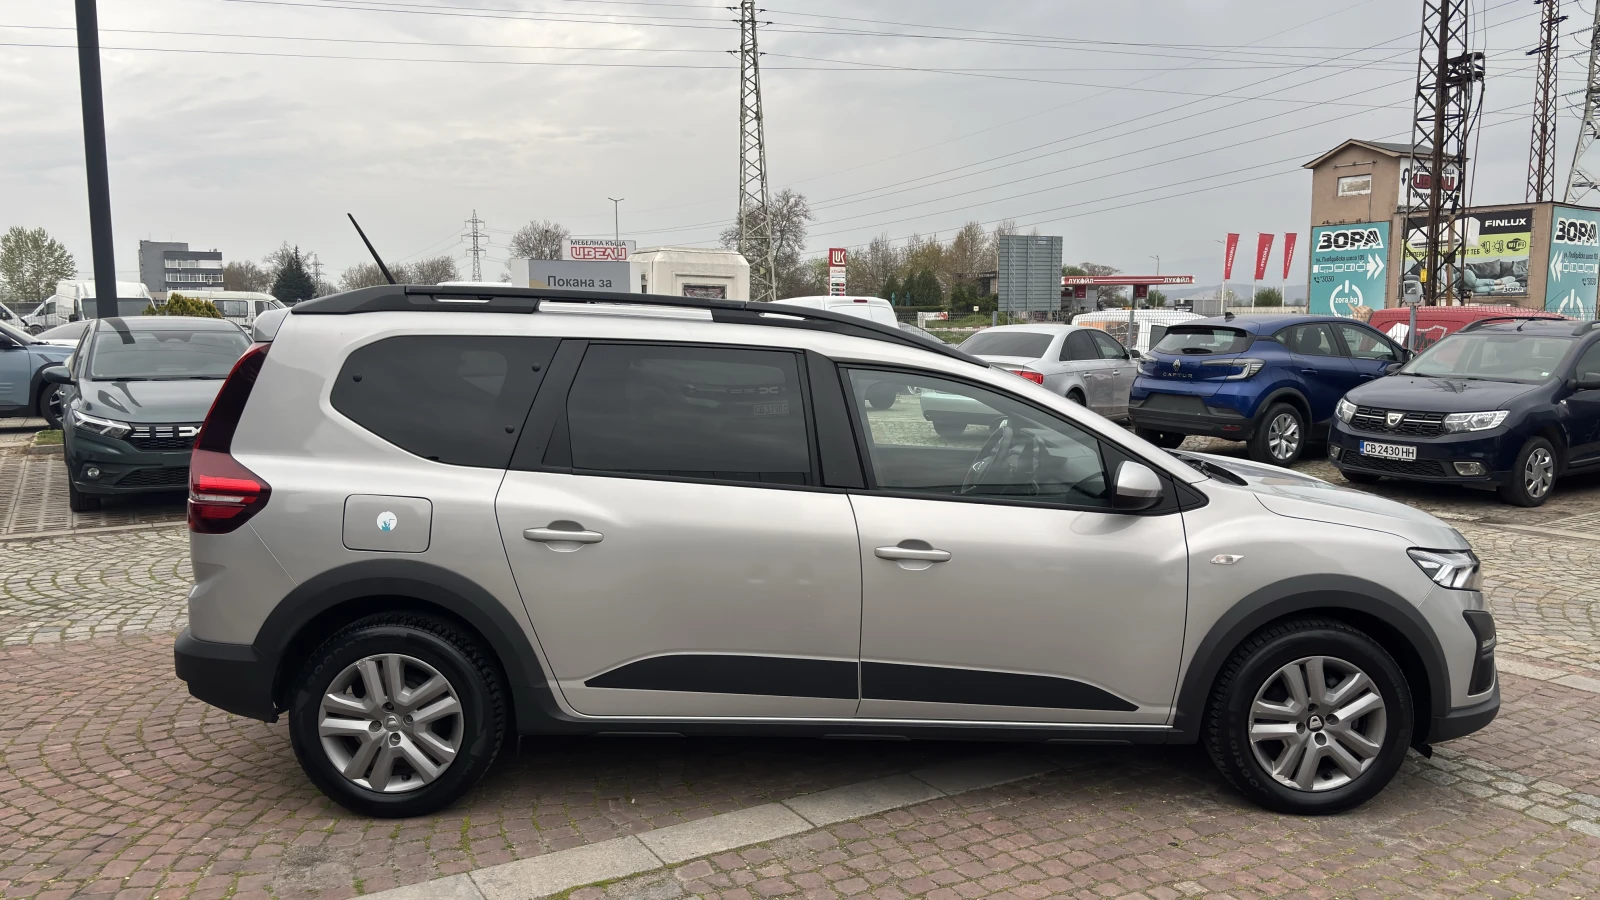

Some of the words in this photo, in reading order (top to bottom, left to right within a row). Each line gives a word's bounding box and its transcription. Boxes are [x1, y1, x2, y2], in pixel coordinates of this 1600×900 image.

[1485, 218, 1527, 228] FINLUX
[1554, 218, 1599, 245] ЗОРА
[1317, 229, 1383, 251] ЗОРА
[571, 246, 627, 260] ИВЕЛИ
[547, 275, 595, 288] Покана
[598, 279, 612, 288] за
[1335, 296, 1358, 304] zora.bg
[1365, 443, 1376, 454] CB
[1377, 445, 1400, 456] 2430
[1401, 447, 1415, 458] HH
